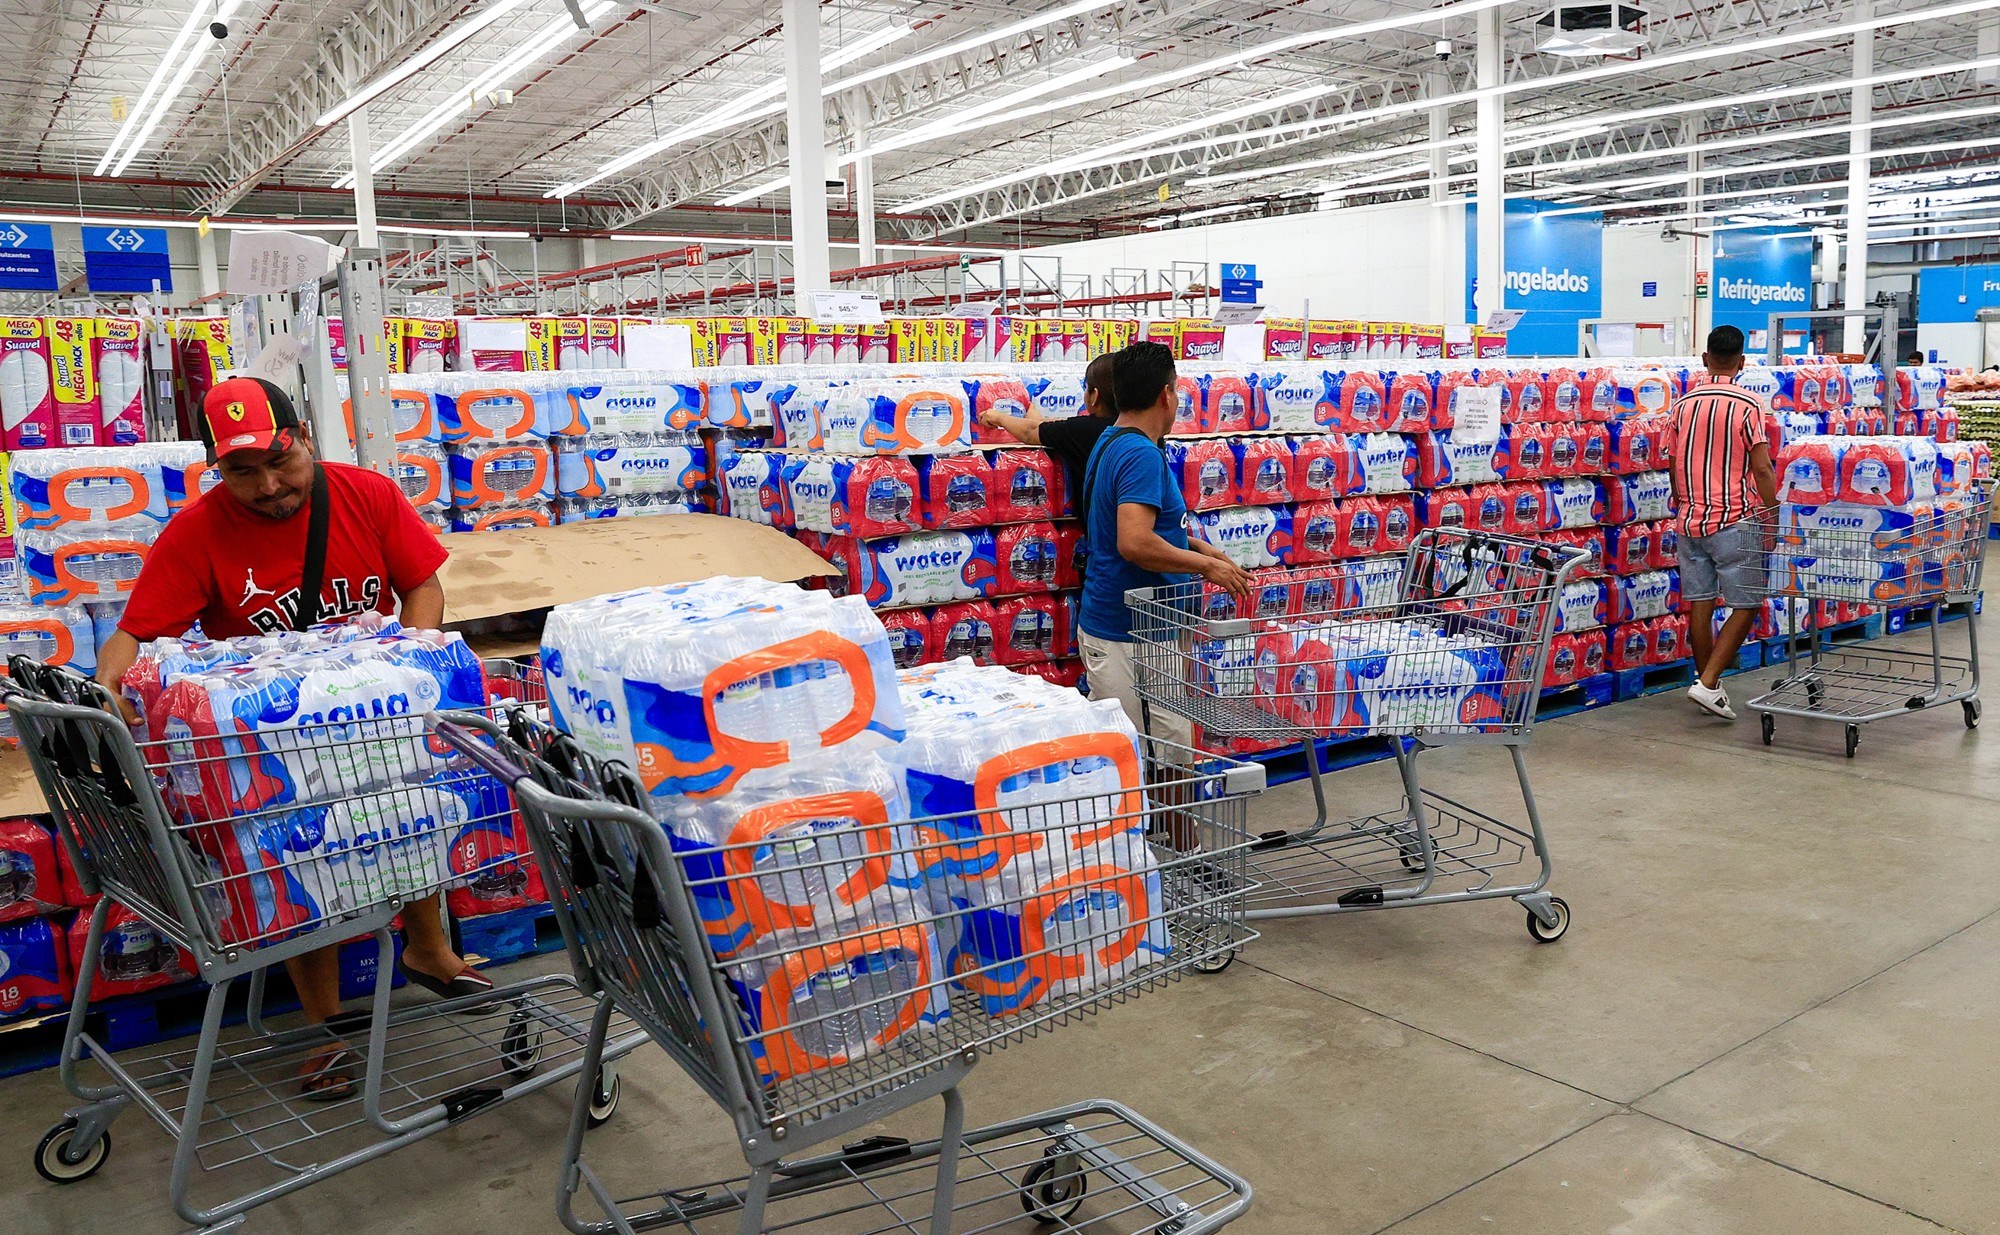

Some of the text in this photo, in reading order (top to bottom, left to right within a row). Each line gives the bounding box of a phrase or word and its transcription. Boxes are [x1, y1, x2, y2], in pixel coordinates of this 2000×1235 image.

[0, 230, 16, 241] 26
[117, 235, 134, 246] 25
[1504, 267, 1589, 296] ngelados
[1983, 280, 2000, 291] Fru
[1719, 277, 1805, 305] Refrigerados
[6, 320, 36, 329] MEGA
[55, 319, 74, 343] 48
[105, 321, 133, 331] MEGA
[421, 323, 443, 332] MEGA
[528, 321, 542, 340] 48
[560, 321, 582, 330] MEGA
[592, 321, 613, 330] MEGA
[696, 320, 708, 337] 48
[728, 320, 747, 328] MEGA
[758, 319, 769, 336] 48
[786, 320, 803, 328] MEGA
[904, 321, 912, 338] 48
[926, 321, 934, 337] 48
[947, 321, 955, 337] 48
[1013, 322, 1023, 337] 48
[1093, 322, 1101, 337] 48
[1114, 323, 1123, 337] 48
[76, 323, 84, 341] rollos
[208, 320, 227, 343] 48
[1045, 334, 1063, 343] Suavel
[5, 339, 41, 351] Suavel
[101, 339, 135, 350] Suavel
[418, 340, 444, 350] Suavel
[559, 338, 585, 347] Suavel
[591, 338, 615, 347] Suavel
[727, 335, 747, 344] Suavel
[784, 335, 804, 344] Suavel
[814, 336, 834, 344] Suavel
[840, 336, 858, 344] Suavel
[869, 337, 889, 346] Suavel
[1069, 335, 1087, 343] Suavel
[389, 342, 398, 362] PACK
[540, 342, 549, 362] PACK
[1185, 340, 1221, 357] Suavel
[1270, 339, 1302, 354] Suavel
[1312, 340, 1342, 355] Suavel
[1416, 344, 1441, 358] Suavel
[1449, 343, 1475, 357] Suavel
[1480, 344, 1506, 358] Suavel
[53, 355, 72, 388] Suavel
[73, 345, 86, 400] MEGA PACK
[1040, 394, 1076, 412] agua
[1275, 388, 1313, 405] agua
[606, 397, 656, 414] agua
[1318, 406, 1326, 415] 18
[676, 409, 687, 418] 45
[1367, 449, 1404, 467] water
[1453, 444, 1492, 459] water
[621, 458, 669, 475] agua
[18, 503, 24, 512] 5
[831, 507, 841, 518] 18
[1818, 516, 1864, 528] agua
[1218, 522, 1269, 541] water
[895, 551, 962, 572] water
[968, 563, 977, 574] 18
[1879, 582, 1889, 591] 45
[1377, 679, 1462, 702] water
[1465, 699, 1478, 712] 18
[298, 692, 411, 741] agua
[325, 815, 437, 867] agua
[458, 842, 476, 861] 18
[338, 876, 376, 888] BOTELLA
[360, 957, 375, 967] MX
[0, 985, 20, 1002] 18
